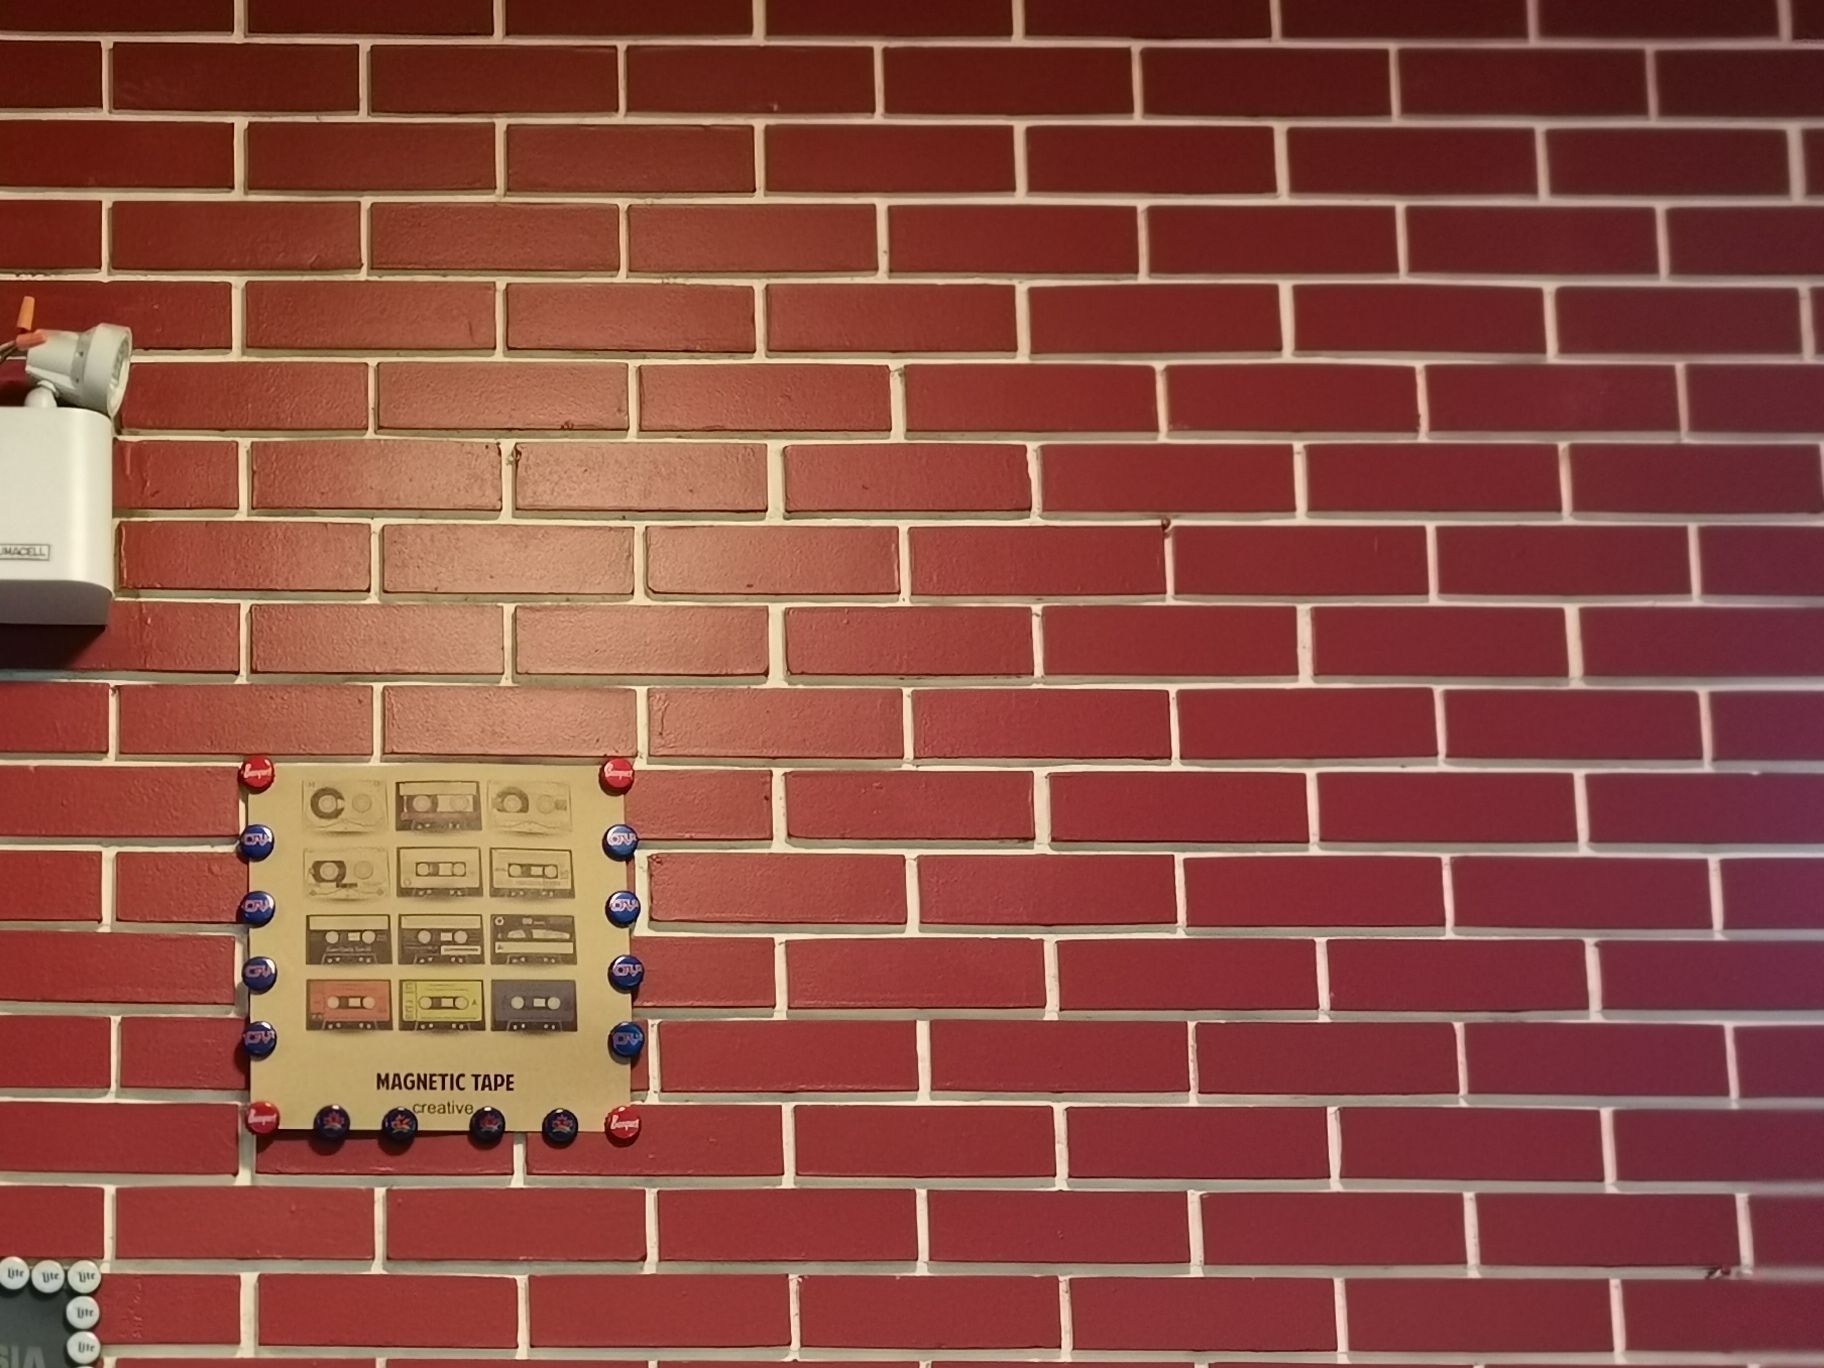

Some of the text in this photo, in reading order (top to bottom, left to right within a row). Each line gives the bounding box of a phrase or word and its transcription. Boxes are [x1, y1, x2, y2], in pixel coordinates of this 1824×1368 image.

[376, 1072, 515, 1092] MAGNETIC TAPE
[412, 1101, 474, 1115] creative
